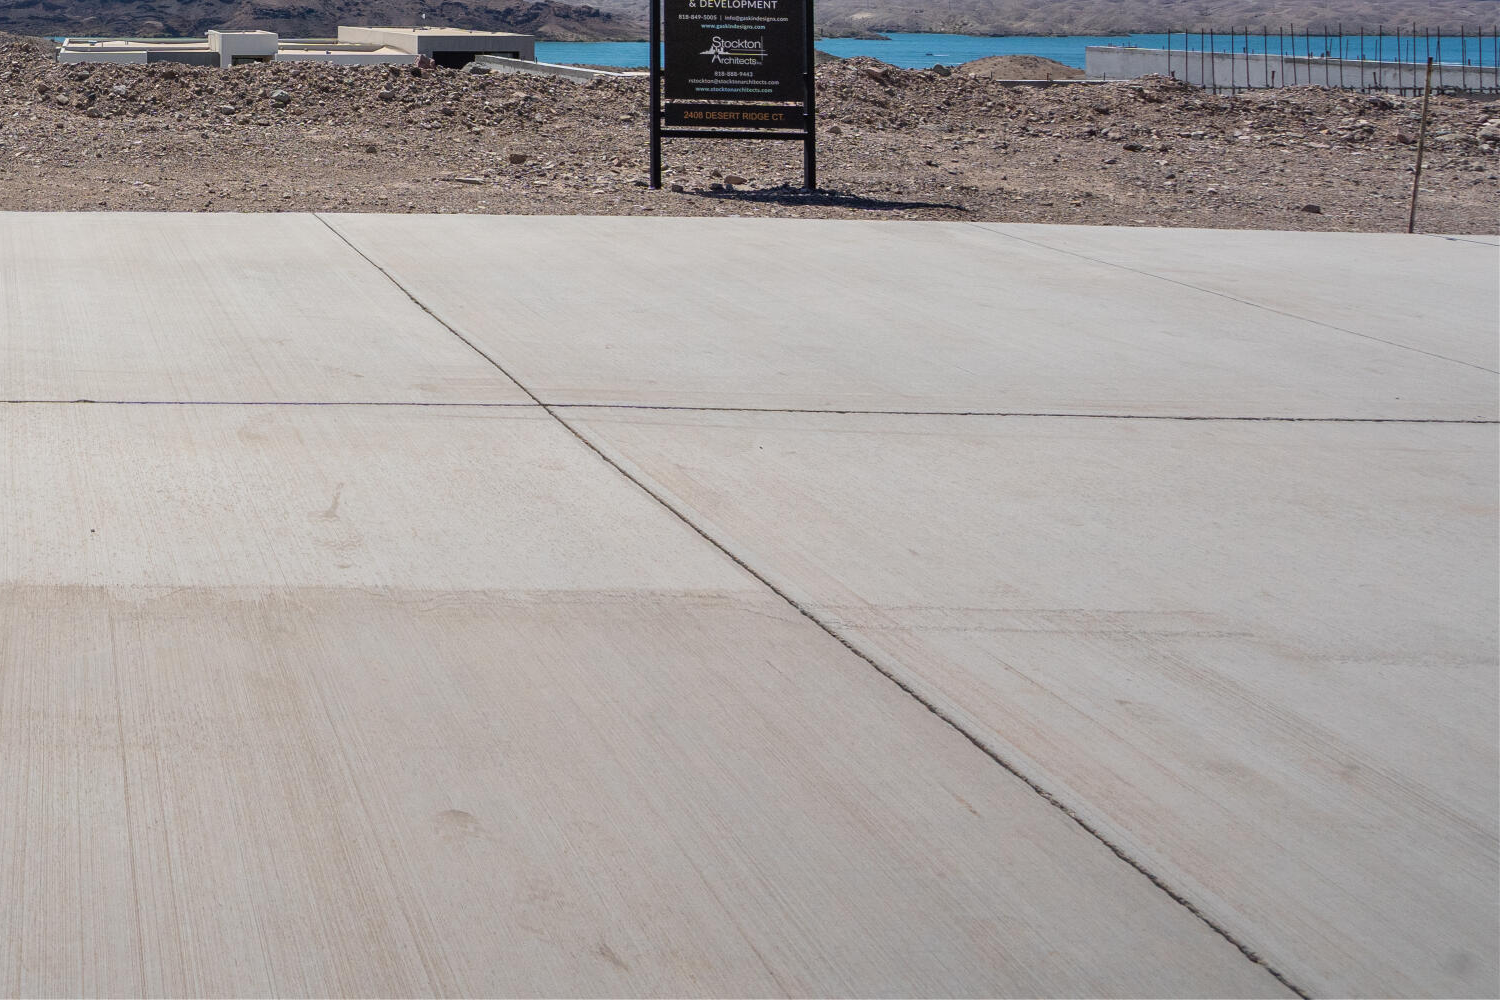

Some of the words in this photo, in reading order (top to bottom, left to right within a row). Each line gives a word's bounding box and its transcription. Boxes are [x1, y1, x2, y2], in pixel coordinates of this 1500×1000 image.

[689, 0, 696, 8] &
[700, 0, 778, 9] DEVELOPMENT
[712, 36, 761, 49] Stockton
[711, 54, 757, 65] Architects
[705, 111, 740, 120] DESERT
[742, 112, 769, 120] RIDGE
[771, 113, 785, 121] CT
